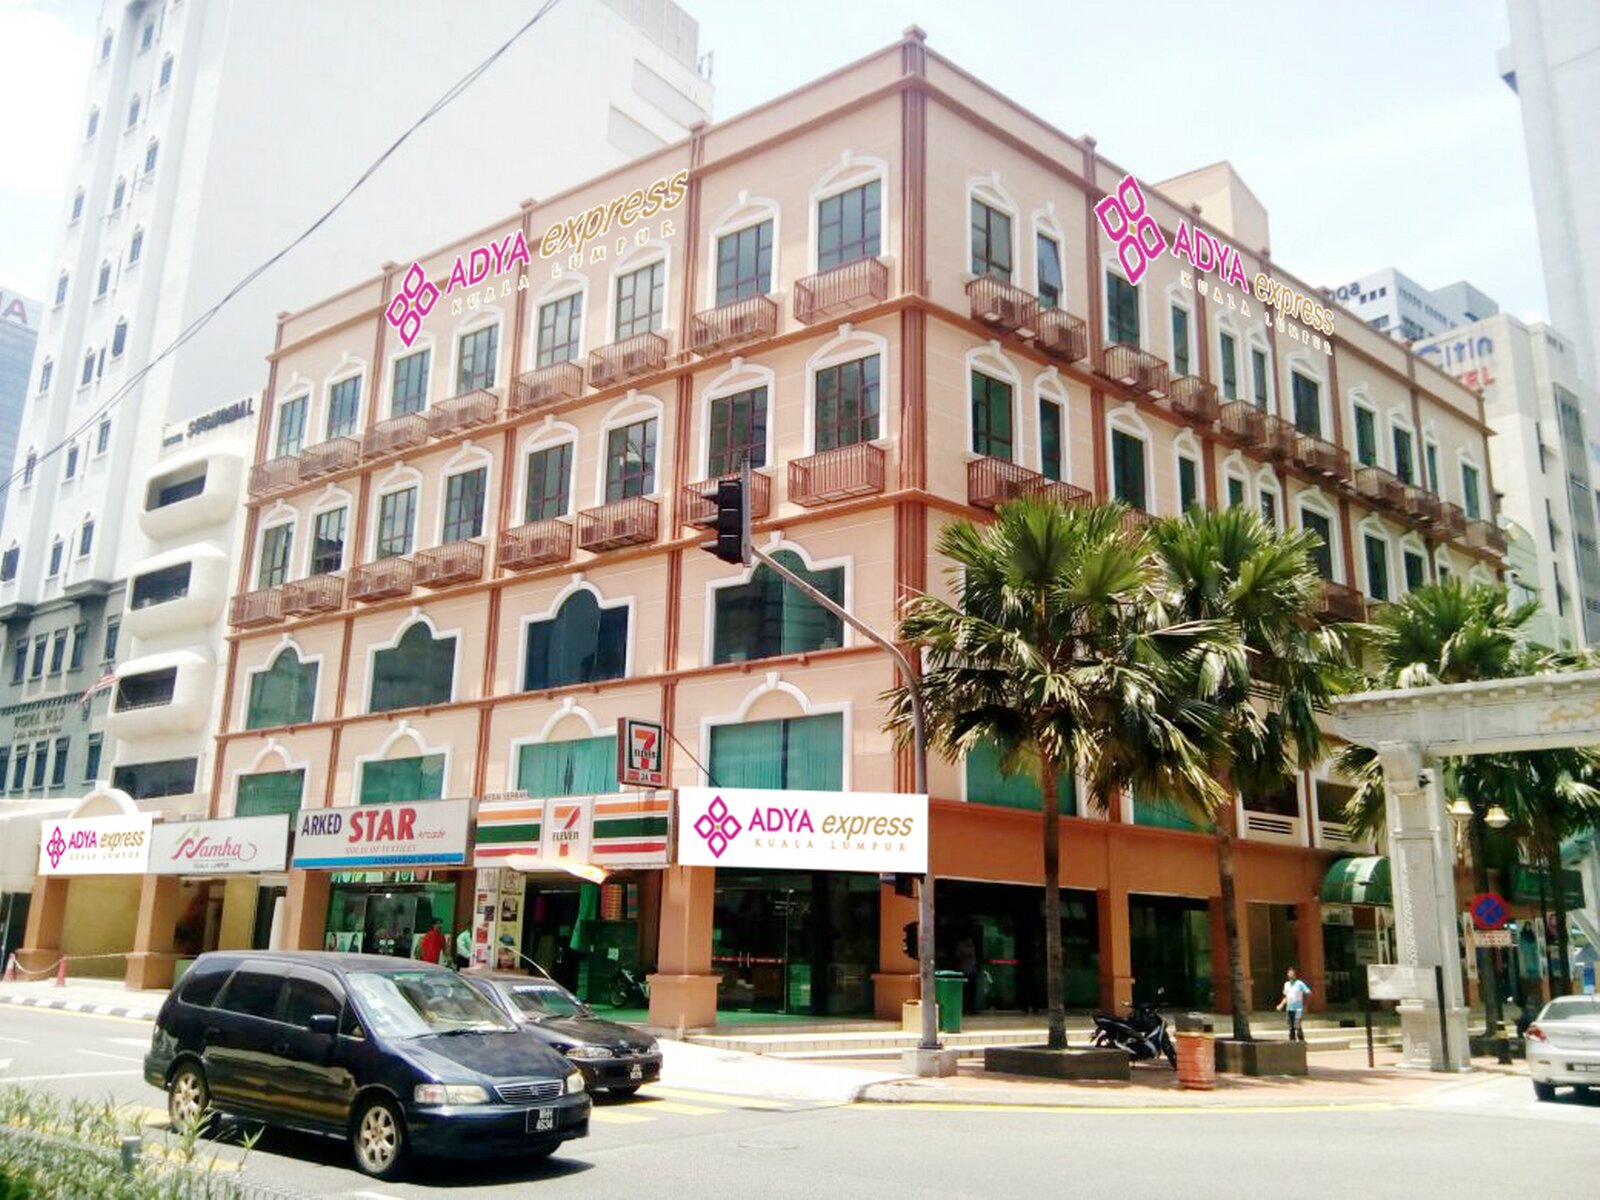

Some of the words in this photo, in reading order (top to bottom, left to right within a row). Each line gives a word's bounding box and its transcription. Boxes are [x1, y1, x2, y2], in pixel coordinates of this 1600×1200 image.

[446, 229, 529, 294] ADYA
[541, 170, 688, 257] express
[451, 275, 530, 315] KUALA
[551, 219, 676, 279] LUMPUR
[1172, 218, 1250, 294] ADYA
[1254, 272, 1335, 336] express
[1180, 270, 1252, 317] KUALA
[1264, 311, 1333, 356] LUMPUR
[68, 831, 98, 849] ADYA
[99, 831, 146, 852] express
[301, 813, 342, 837] ARKED
[348, 808, 417, 844] STAR
[748, 807, 814, 833] ADYA
[821, 814, 914, 841] express
[755, 838, 814, 849] KUALA
[830, 841, 906, 852] LUMPUR
